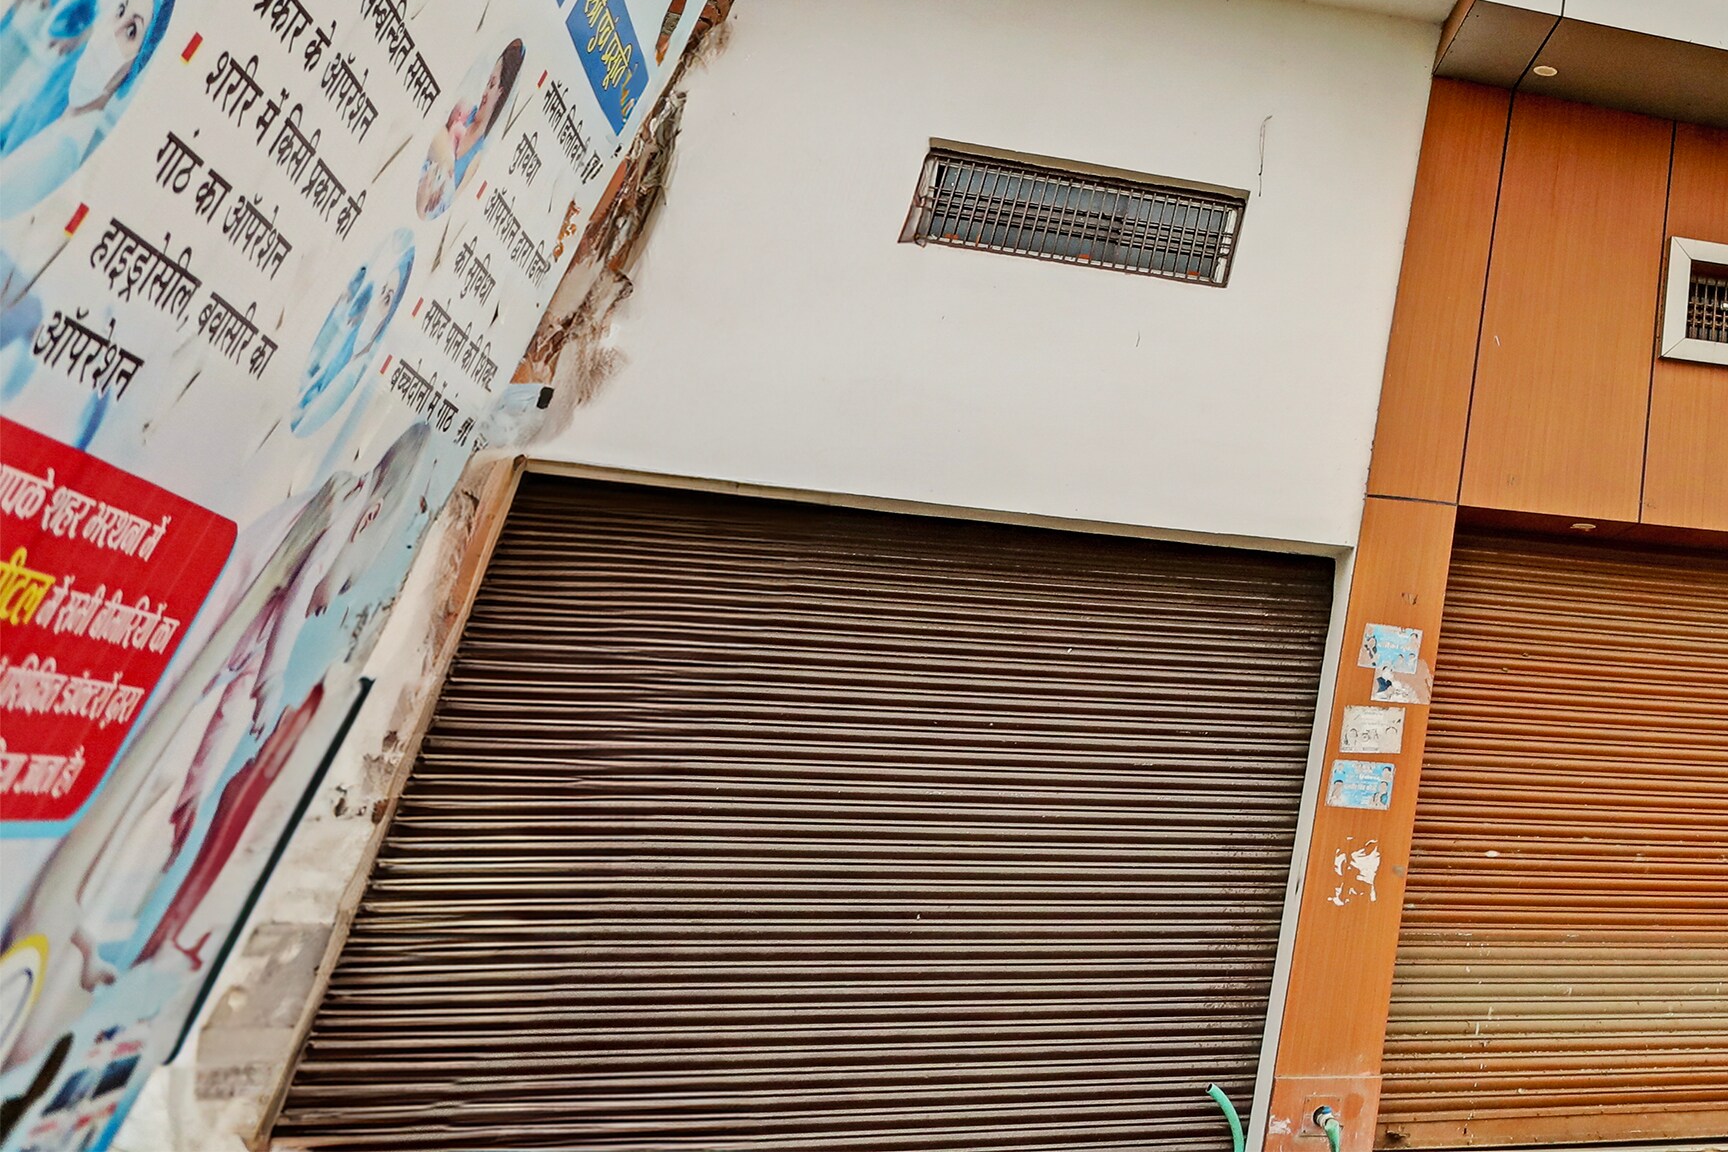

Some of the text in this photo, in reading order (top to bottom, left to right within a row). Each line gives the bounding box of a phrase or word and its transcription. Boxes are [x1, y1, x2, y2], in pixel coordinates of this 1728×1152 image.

[586, 7, 619, 52] एवं
[303, 19, 337, 72] के
[320, 51, 378, 143] ऑपरेशन
[405, 50, 441, 118] समस्त
[542, 80, 569, 131] नॉर्मल
[204, 50, 366, 240] शरीर में किसी प्रकार की
[508, 131, 542, 185] सुविधा
[155, 128, 292, 279] गांठ का ऑपरेशन
[483, 187, 521, 248] ऑपरेशन
[510, 230, 534, 259] द्वारा
[454, 235, 496, 305] की सुविधा
[32, 307, 145, 401] ऑपरेशन
[197, 291, 259, 364] बवासीर
[248, 333, 278, 380] का
[424, 298, 451, 339] सफेद
[444, 321, 472, 358] पानी
[461, 334, 483, 372] की
[390, 358, 437, 413] बच्चेदानी
[426, 381, 447, 421] में
[435, 393, 459, 432] गांठ
[41, 486, 96, 538] शहर
[81, 501, 151, 556] भरथना
[138, 515, 171, 561] में
